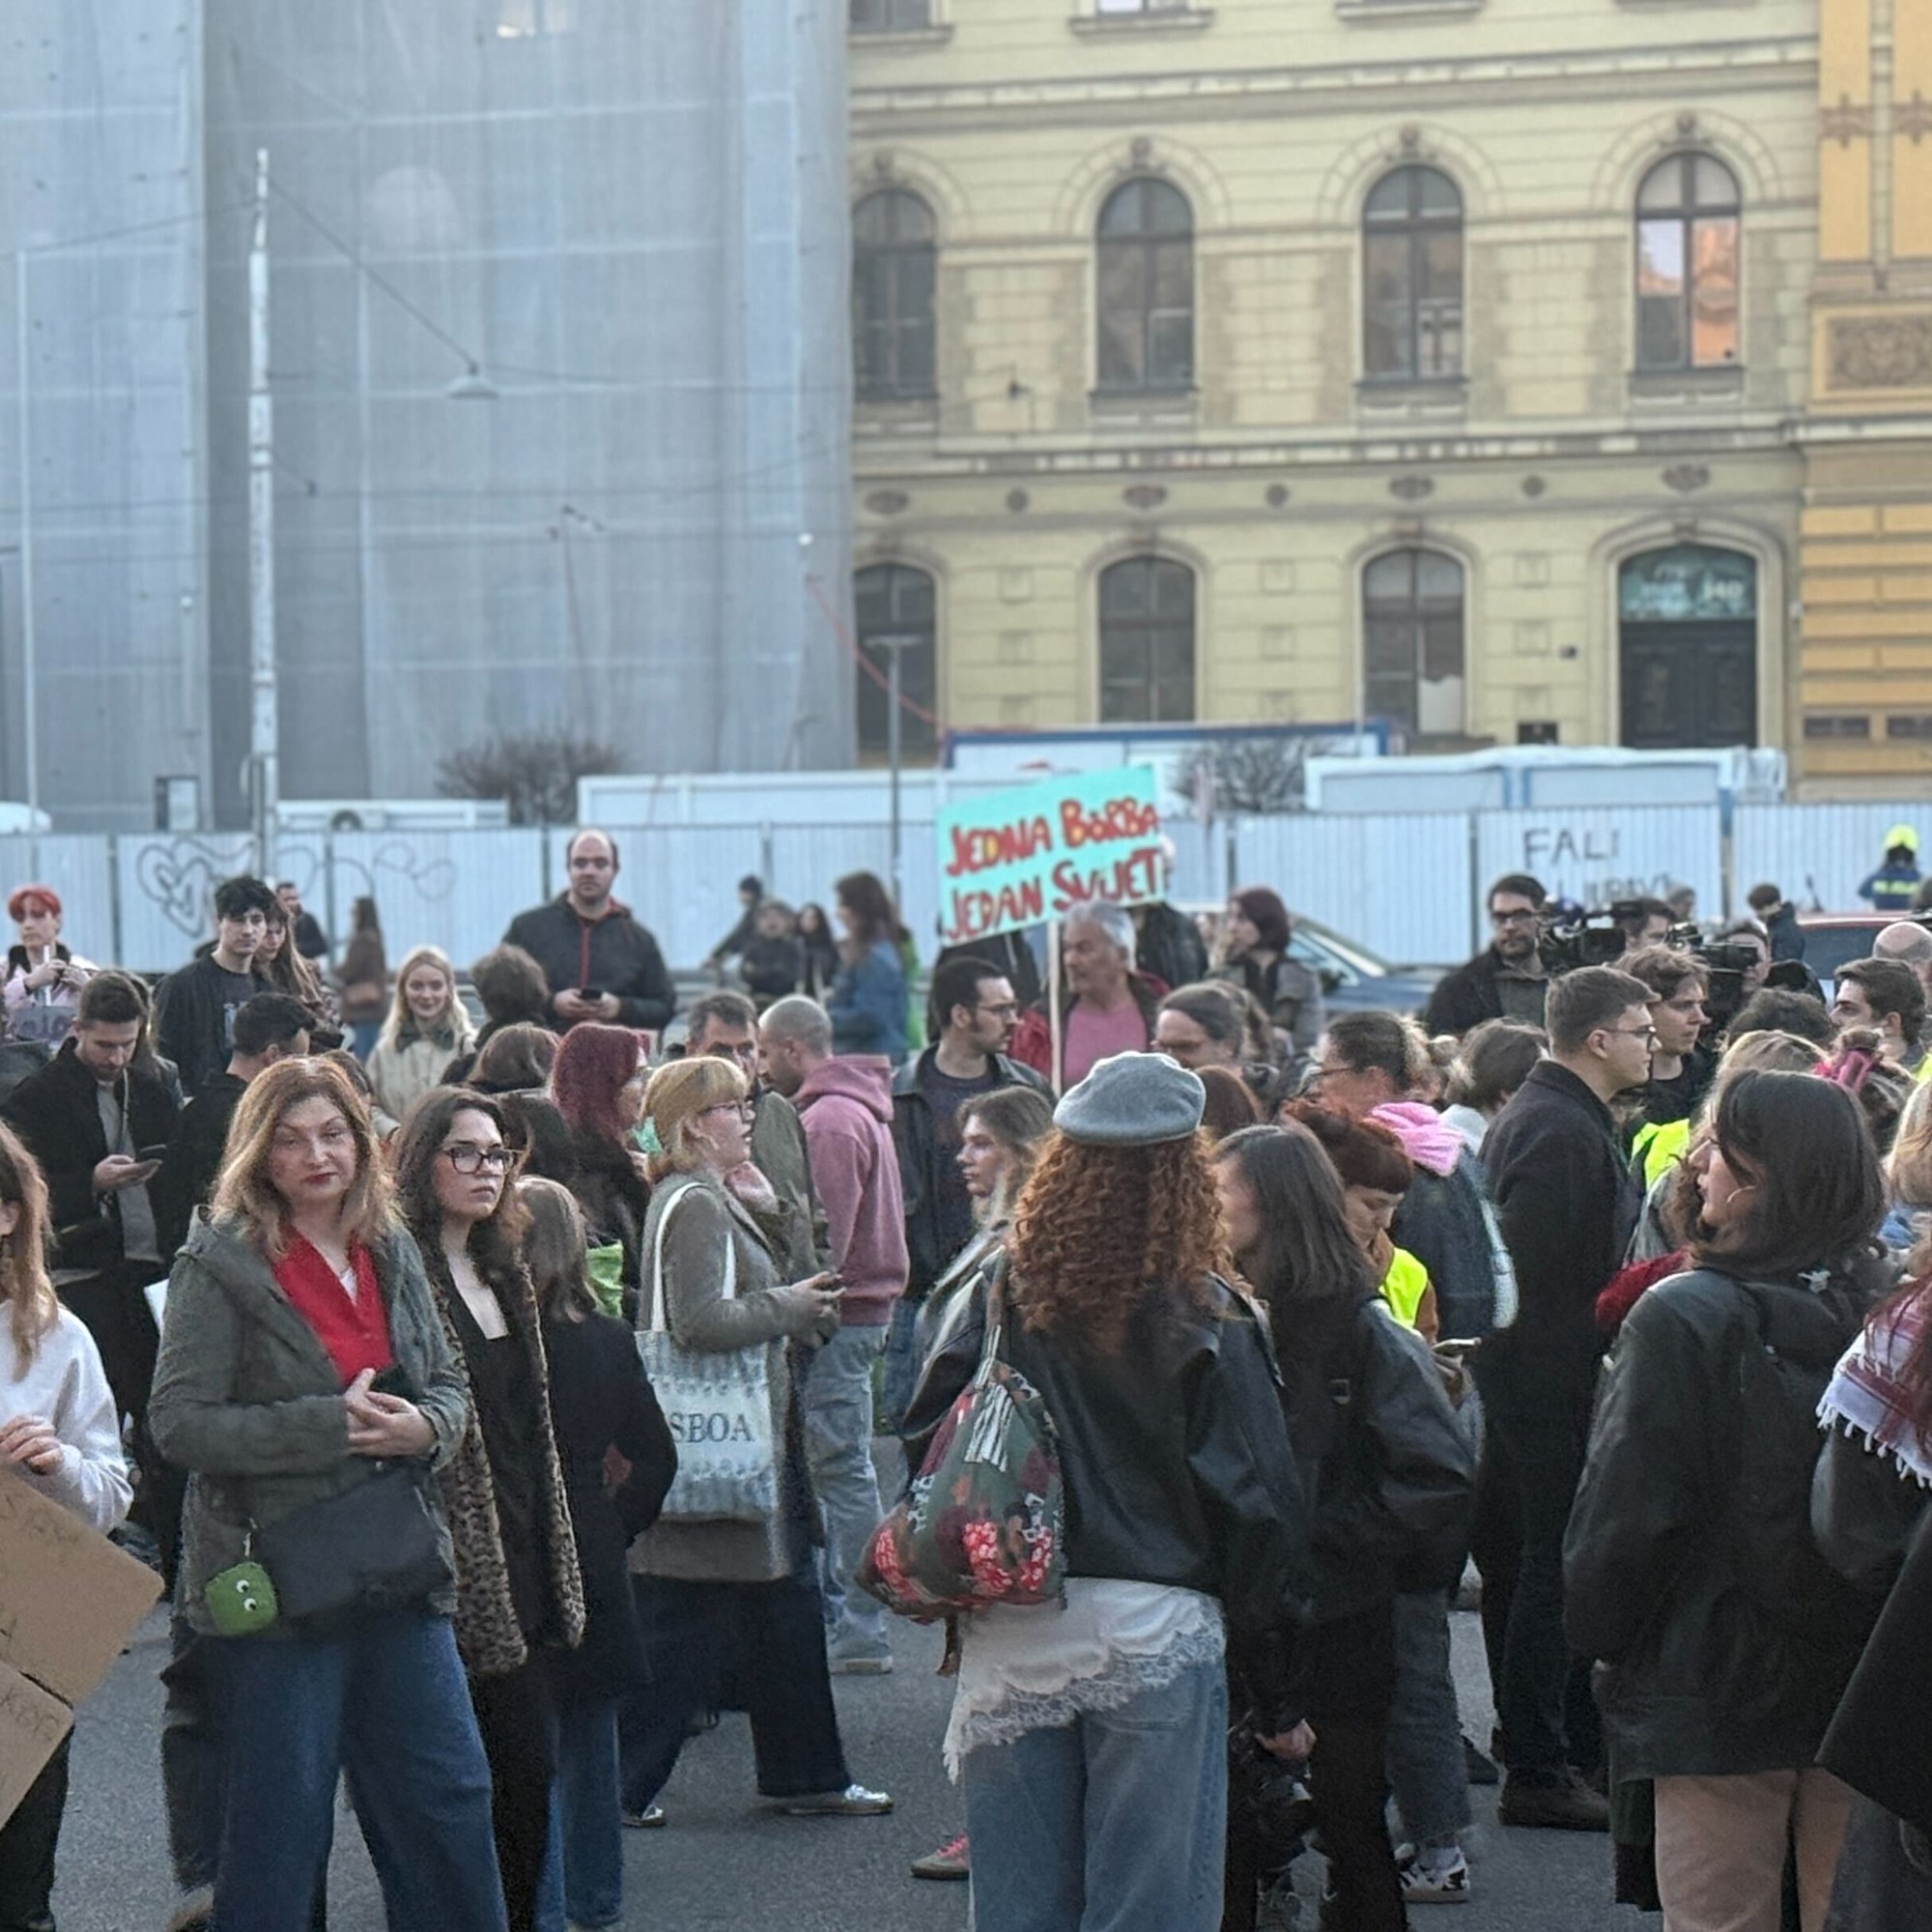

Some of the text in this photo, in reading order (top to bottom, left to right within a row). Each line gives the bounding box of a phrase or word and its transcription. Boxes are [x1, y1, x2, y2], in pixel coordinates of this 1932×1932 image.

[947, 817, 1052, 876] JEDNA
[1522, 828, 1619, 868] FALI
[946, 875, 1043, 940] JEDAN
